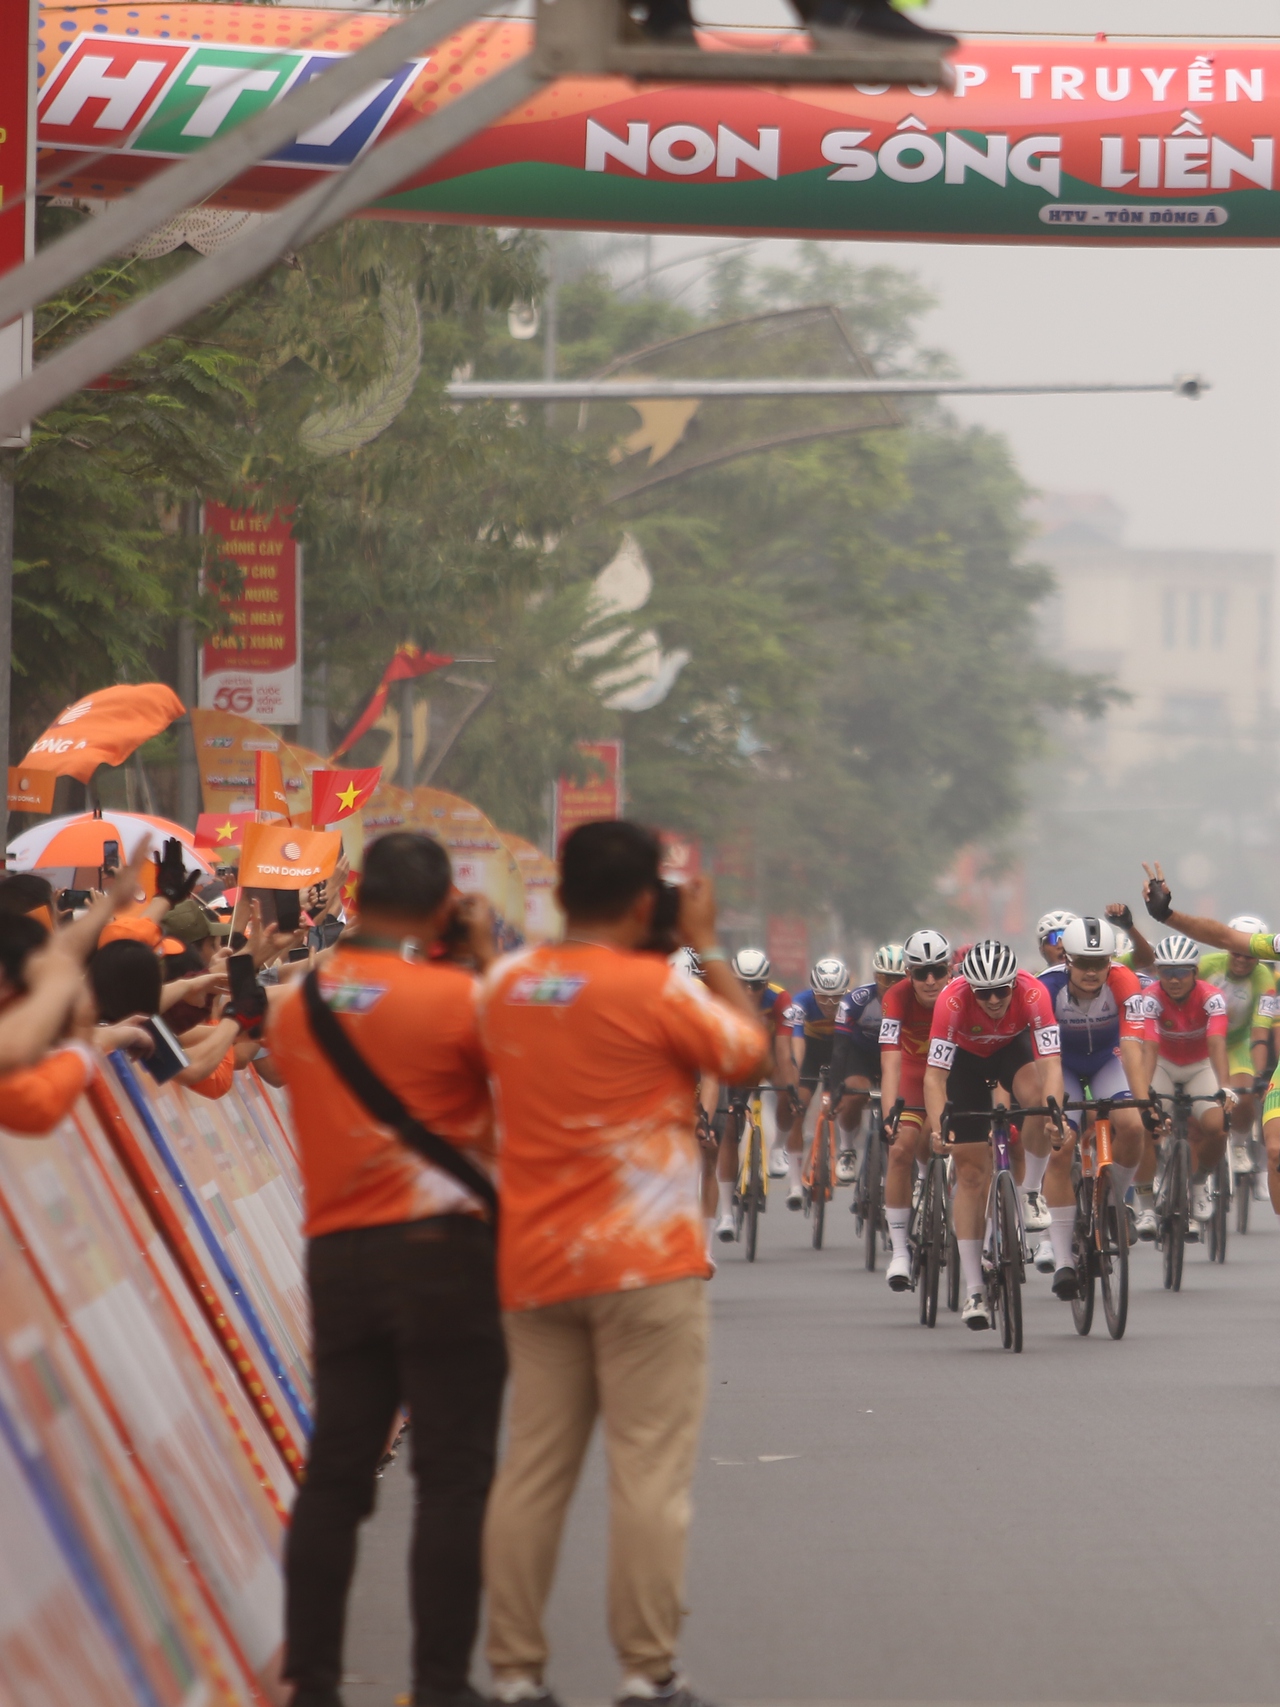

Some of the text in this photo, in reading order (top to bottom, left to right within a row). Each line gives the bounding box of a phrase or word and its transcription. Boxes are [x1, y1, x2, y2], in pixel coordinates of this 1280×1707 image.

[1011, 55, 1264, 102] TRUYỀN
[585, 118, 780, 181] NON
[820, 113, 1061, 199] SÔNG
[1100, 109, 1275, 191] LIỀN
[1049, 210, 1088, 222] HTV
[1105, 208, 1144, 223] TÔN
[1205, 208, 1218, 223] Á
[256, 865, 321, 877] TON DONG A
[882, 1022, 898, 1037] 27
[1041, 1030, 1058, 1048] 87
[933, 1044, 954, 1062] 87
